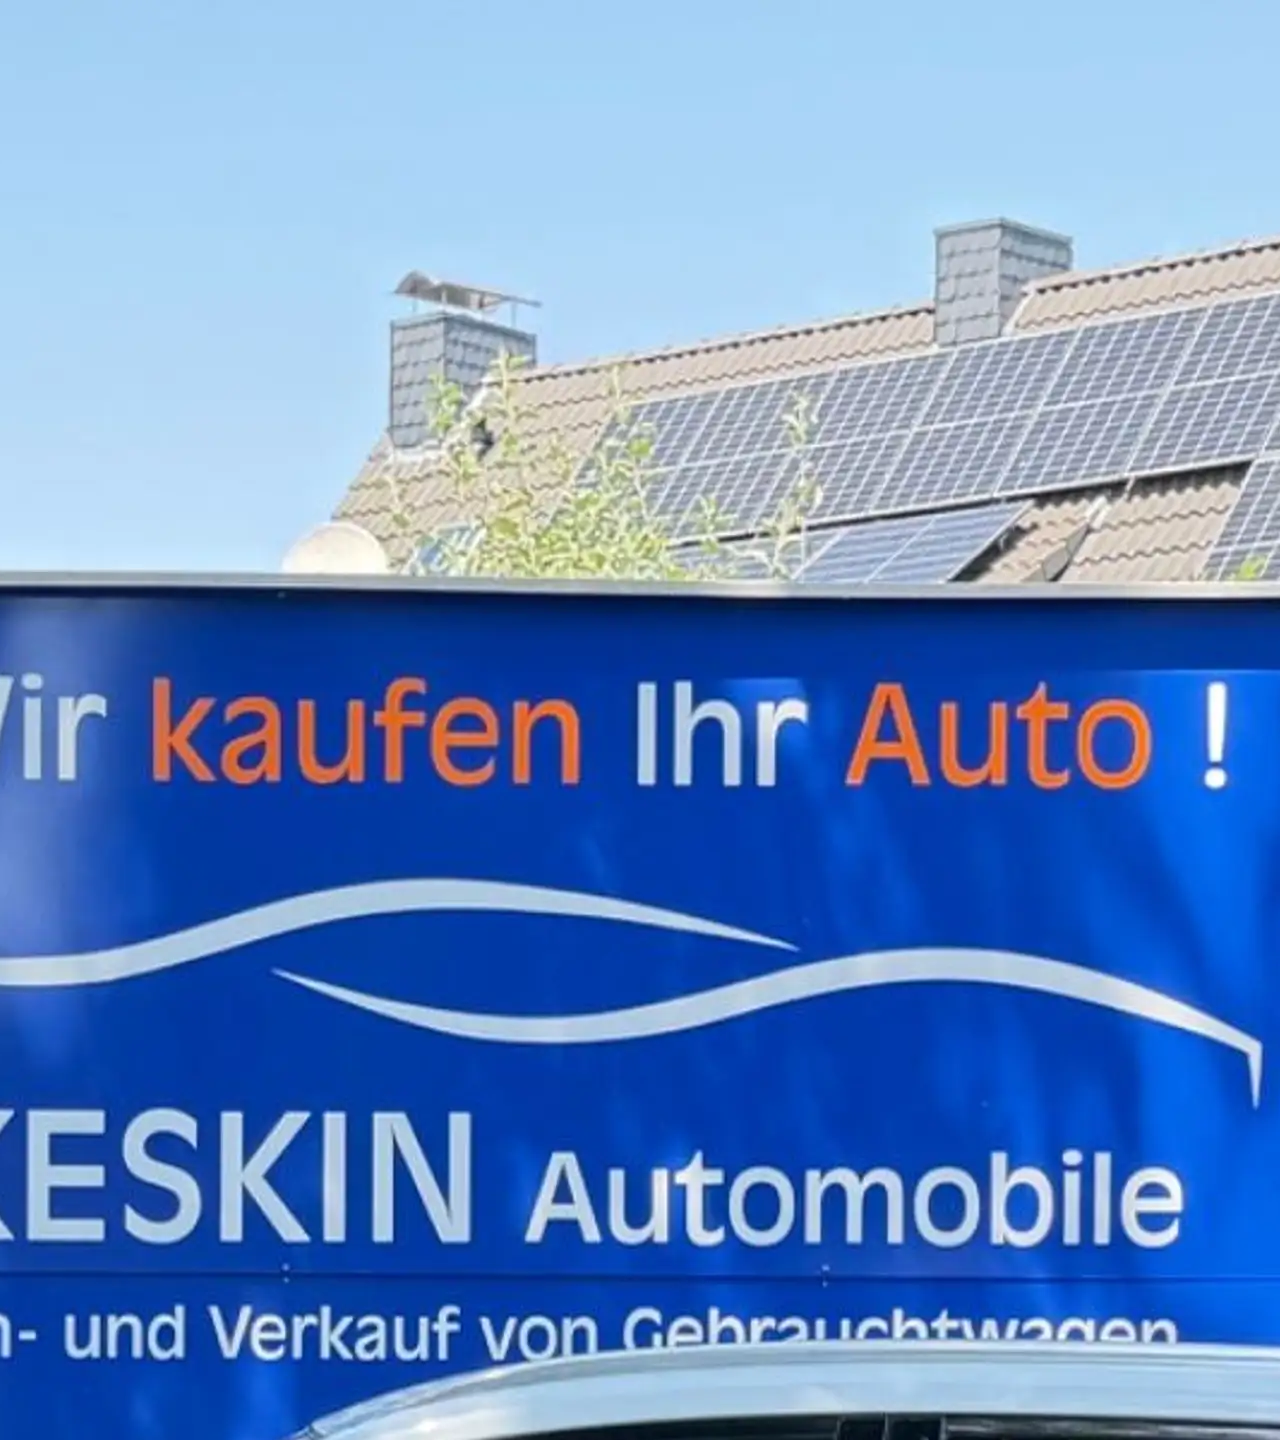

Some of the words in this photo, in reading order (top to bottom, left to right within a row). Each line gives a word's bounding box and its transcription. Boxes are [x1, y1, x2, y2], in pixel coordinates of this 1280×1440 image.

[151, 677, 581, 786] kaufen
[636, 681, 809, 786] Ihr
[846, 682, 1150, 790] Auto
[1204, 680, 1229, 789] !
[524, 1149, 1185, 1248] Automobile
[62, 1305, 185, 1360] und
[208, 1304, 462, 1361] Verkauf
[478, 1315, 599, 1361] von
